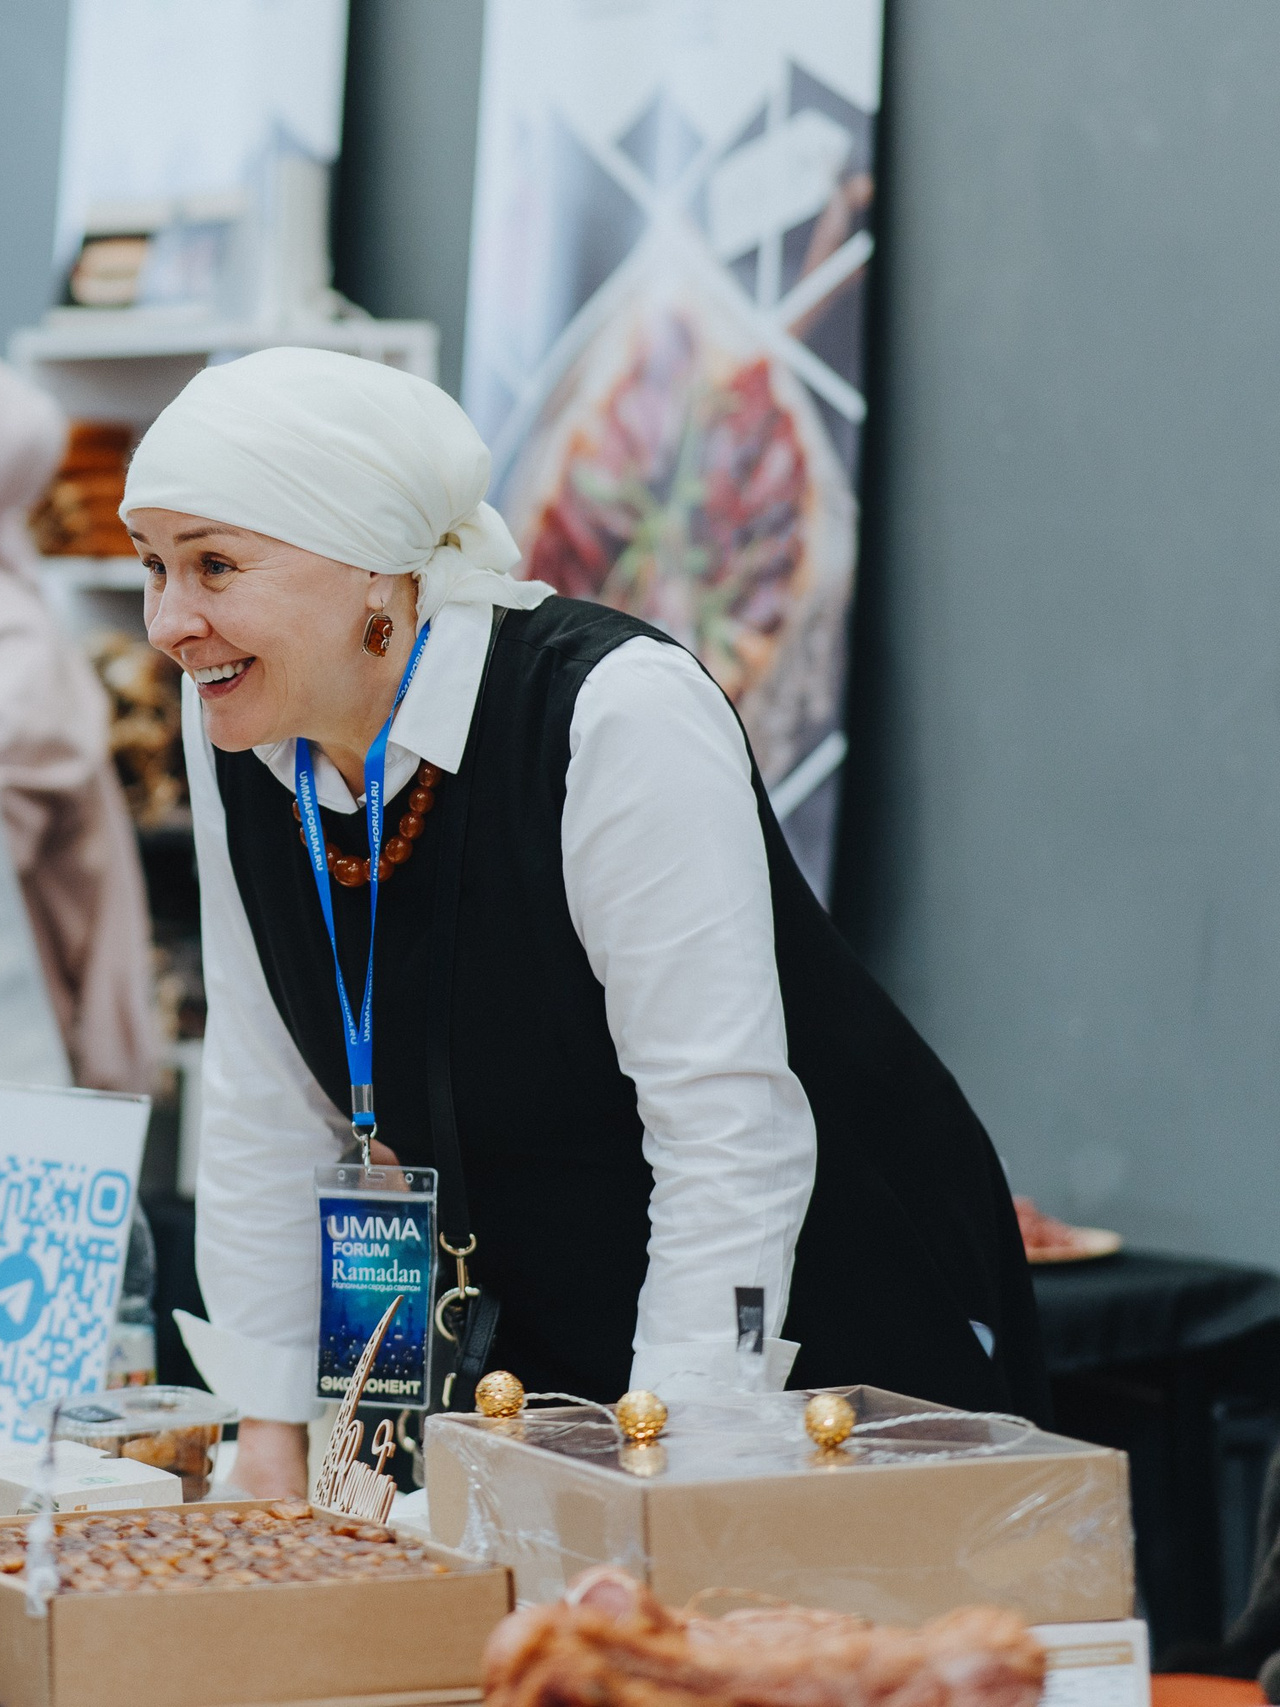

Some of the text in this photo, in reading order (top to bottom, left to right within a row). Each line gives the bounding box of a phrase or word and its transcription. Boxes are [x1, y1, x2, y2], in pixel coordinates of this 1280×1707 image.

[299, 770, 324, 872] UMMAFORUM.RU
[326, 1214, 422, 1242] UMMA
[332, 1241, 390, 1258] FORUM
[331, 1258, 422, 1284] Ramadan
[320, 1375, 422, 1396] ЭКСОНЕНТ
